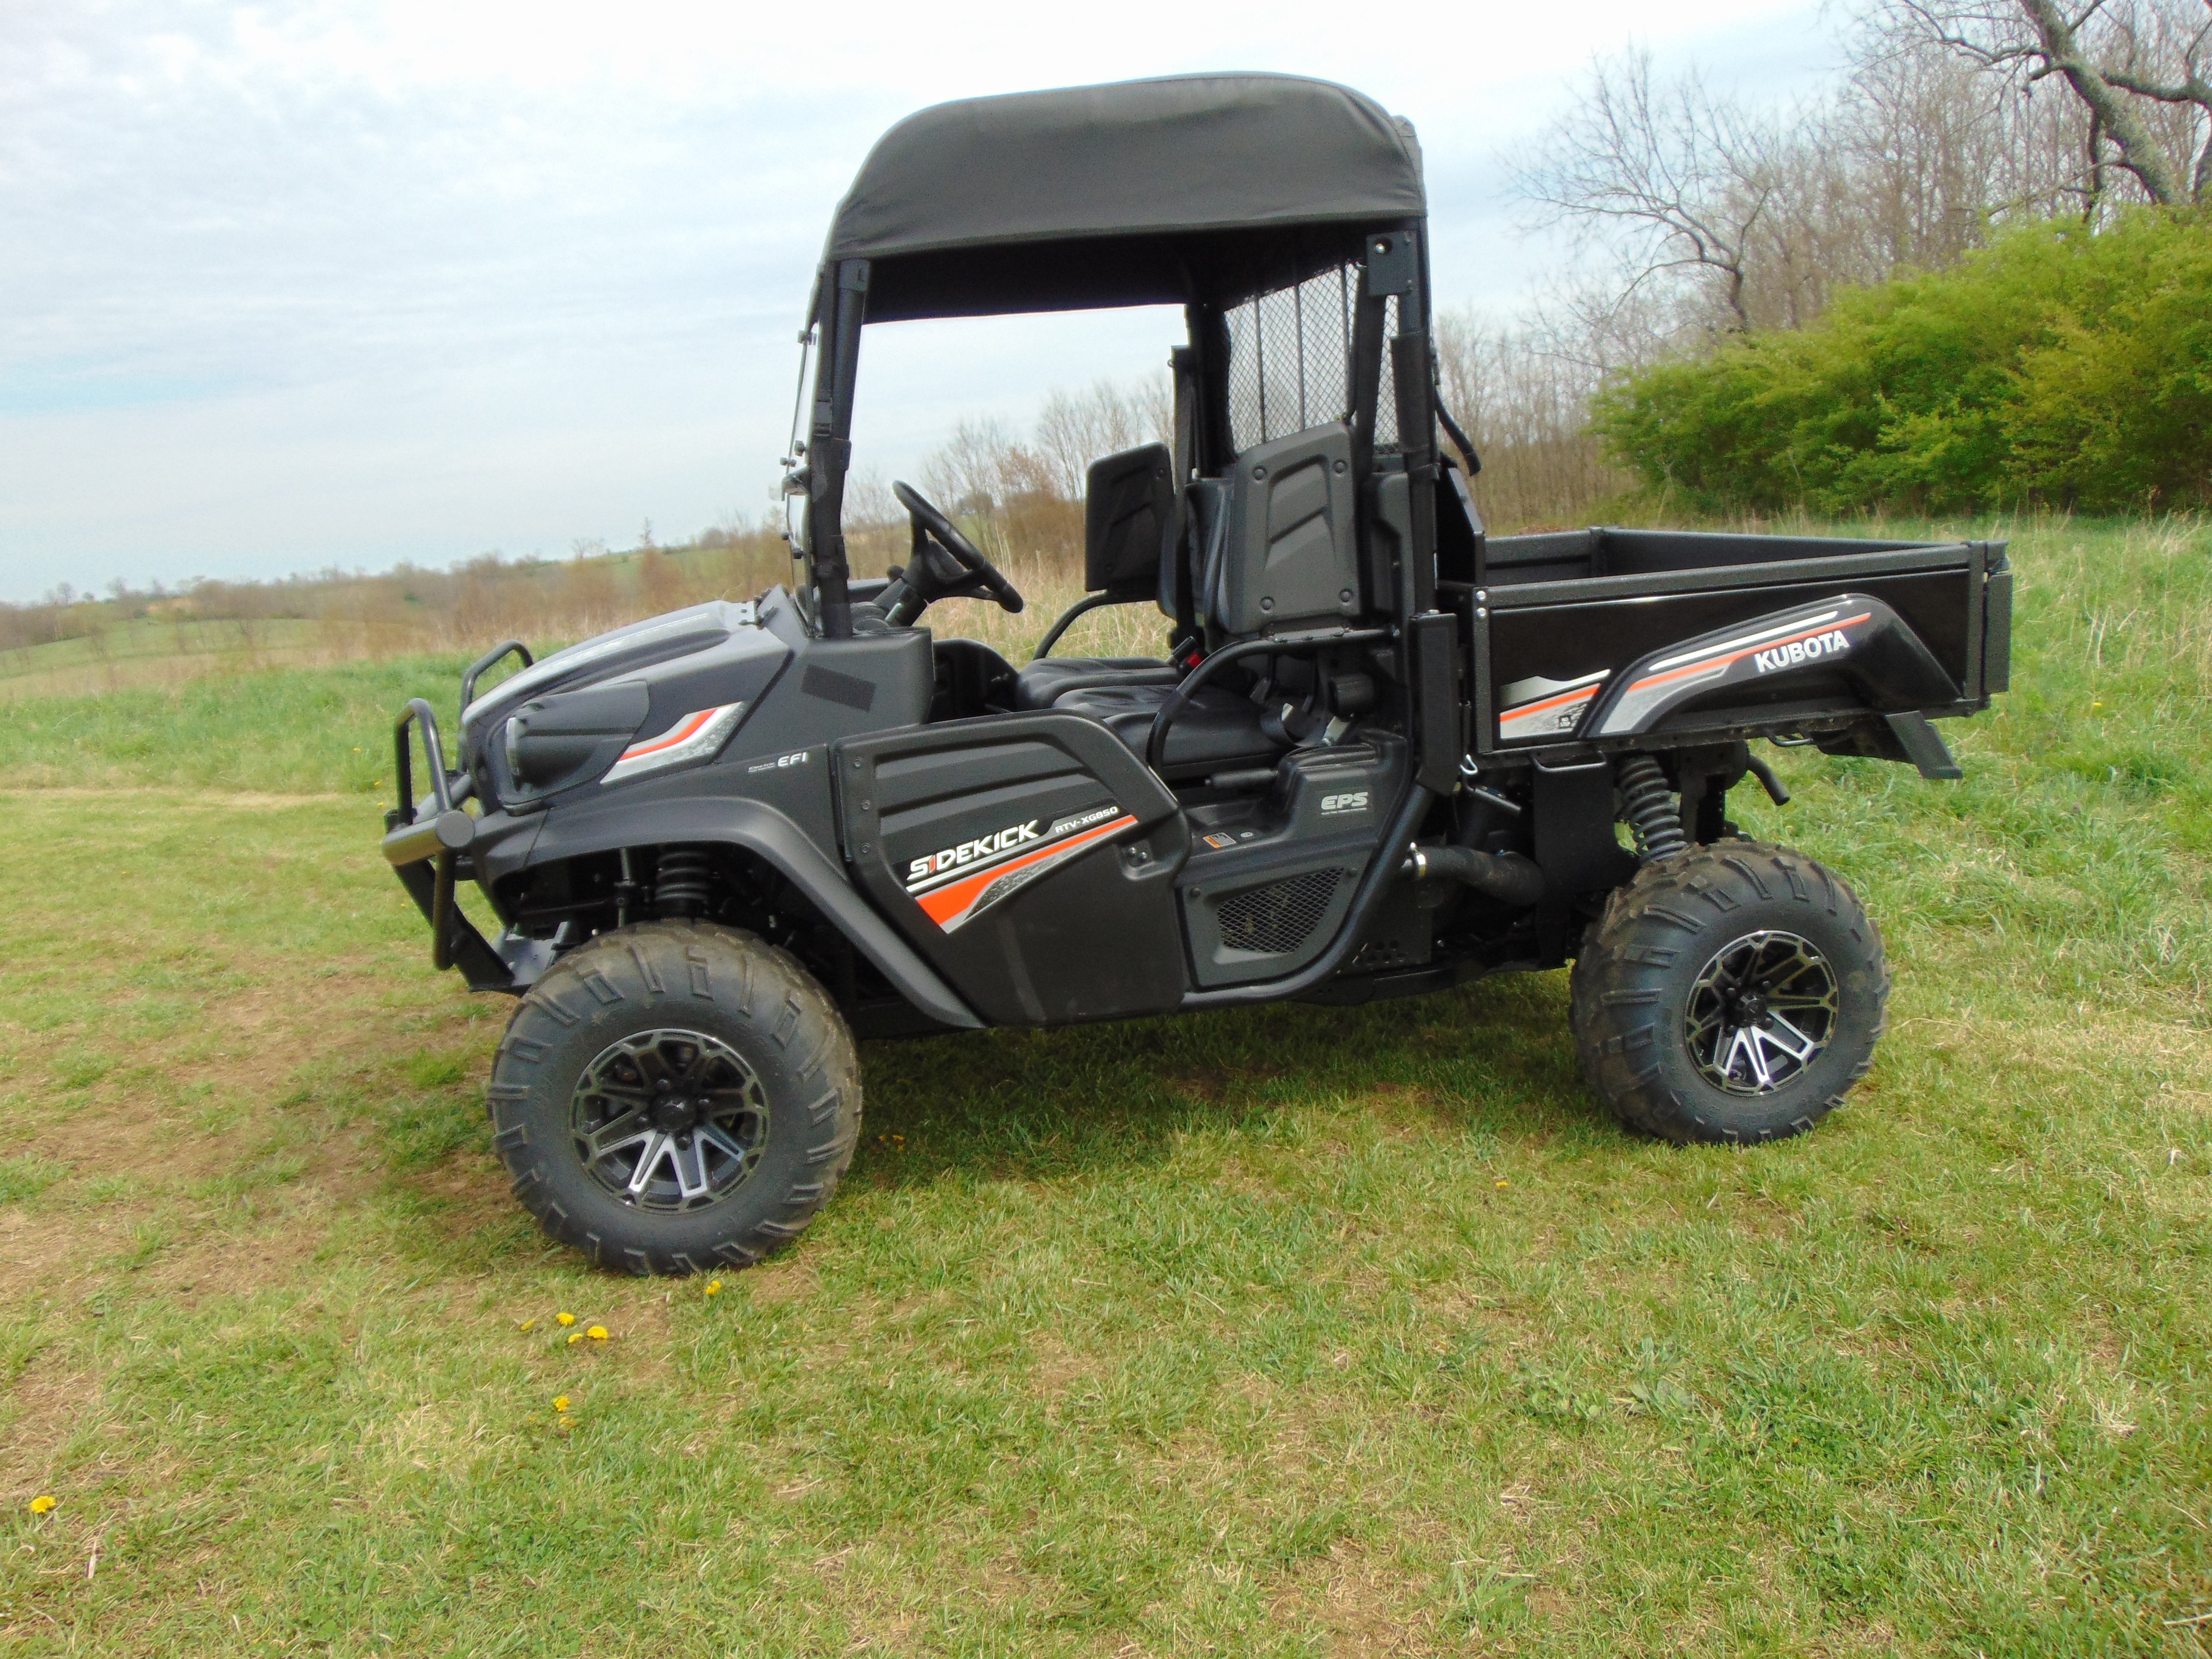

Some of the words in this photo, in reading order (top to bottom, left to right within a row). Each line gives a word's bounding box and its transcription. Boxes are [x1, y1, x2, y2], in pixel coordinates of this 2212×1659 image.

[1755, 630, 1850, 672] KUBOTA
[778, 752, 807, 767] EFI
[1321, 792, 1368, 810] EPS
[906, 819, 1040, 881] SIDEKICK
[1054, 806, 1118, 833] RTV-XG850
